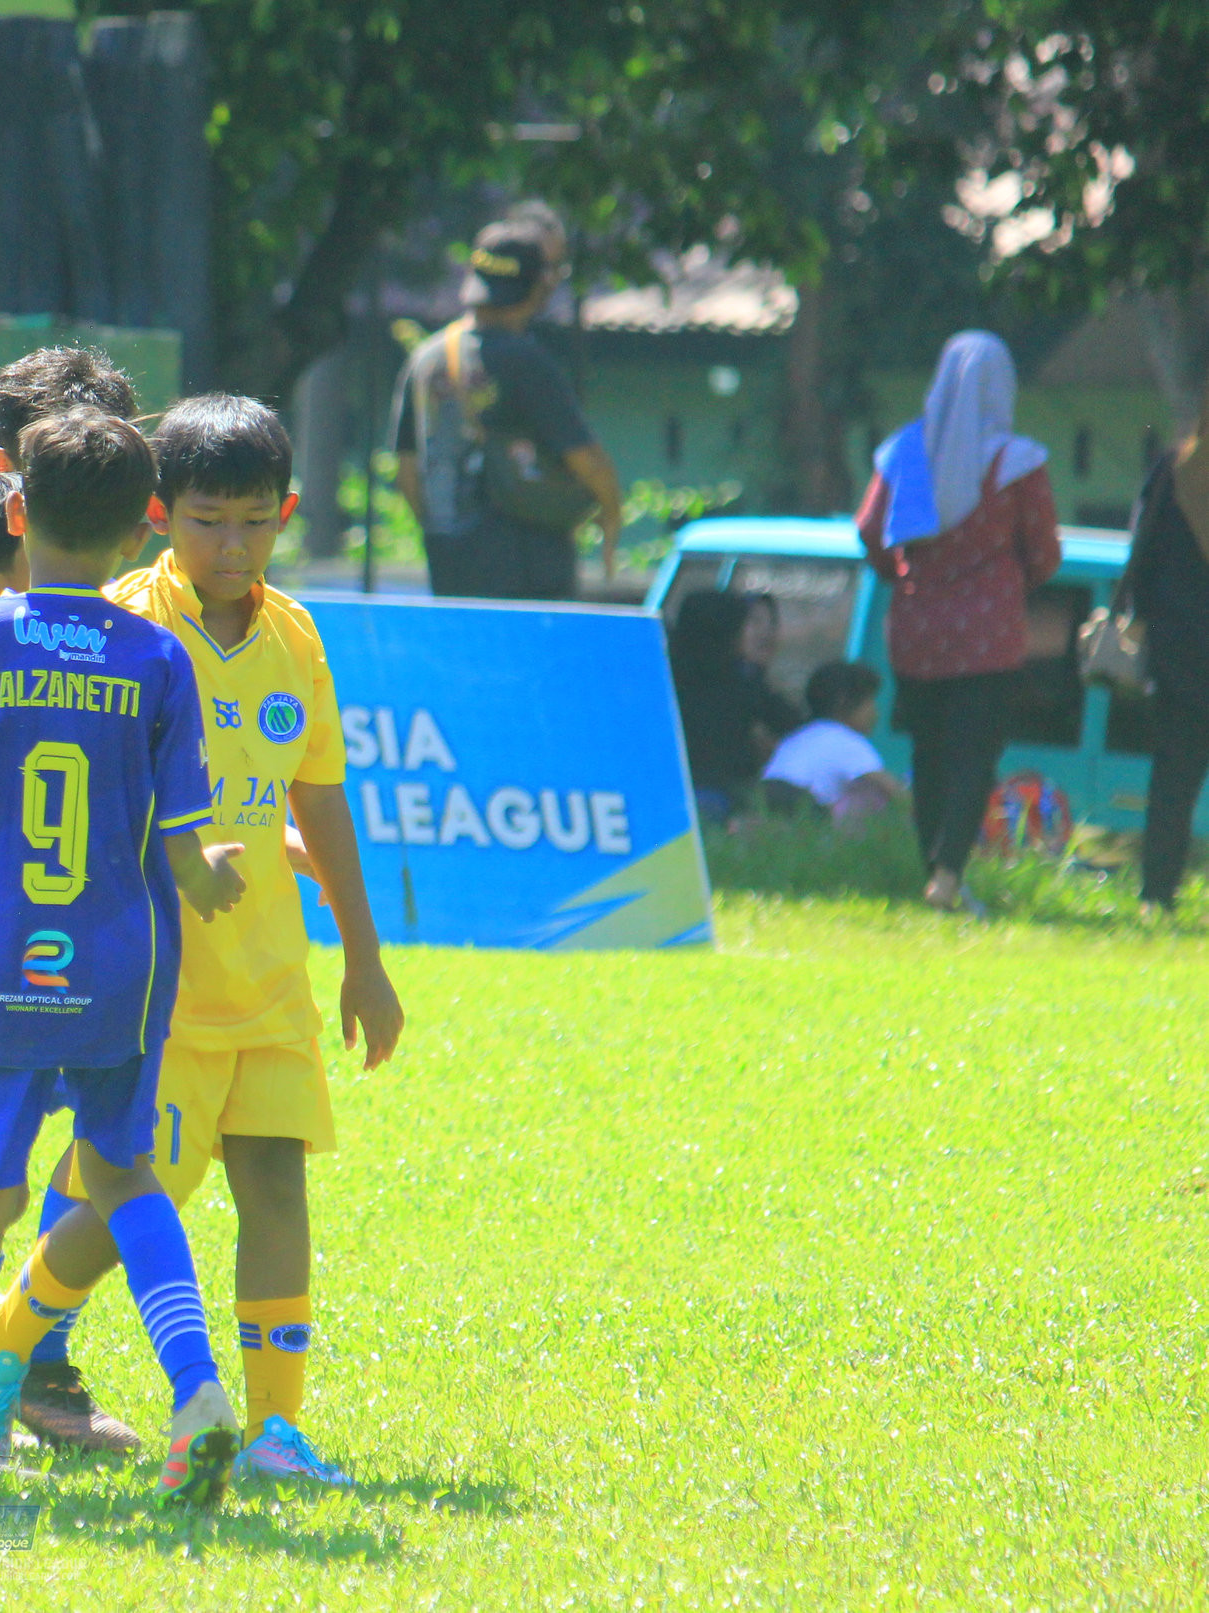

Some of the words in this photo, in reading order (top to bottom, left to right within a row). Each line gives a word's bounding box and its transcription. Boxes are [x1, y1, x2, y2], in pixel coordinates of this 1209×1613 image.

[70, 652, 106, 664] mandiri
[18, 741, 91, 905] 9
[360, 780, 632, 855] LEAGUE
[0, 994, 24, 1003] REZAM
[25, 995, 62, 1005] OPTICAL
[63, 997, 93, 1006] GROUP
[39, 1006, 83, 1014] EXCELLENCE
